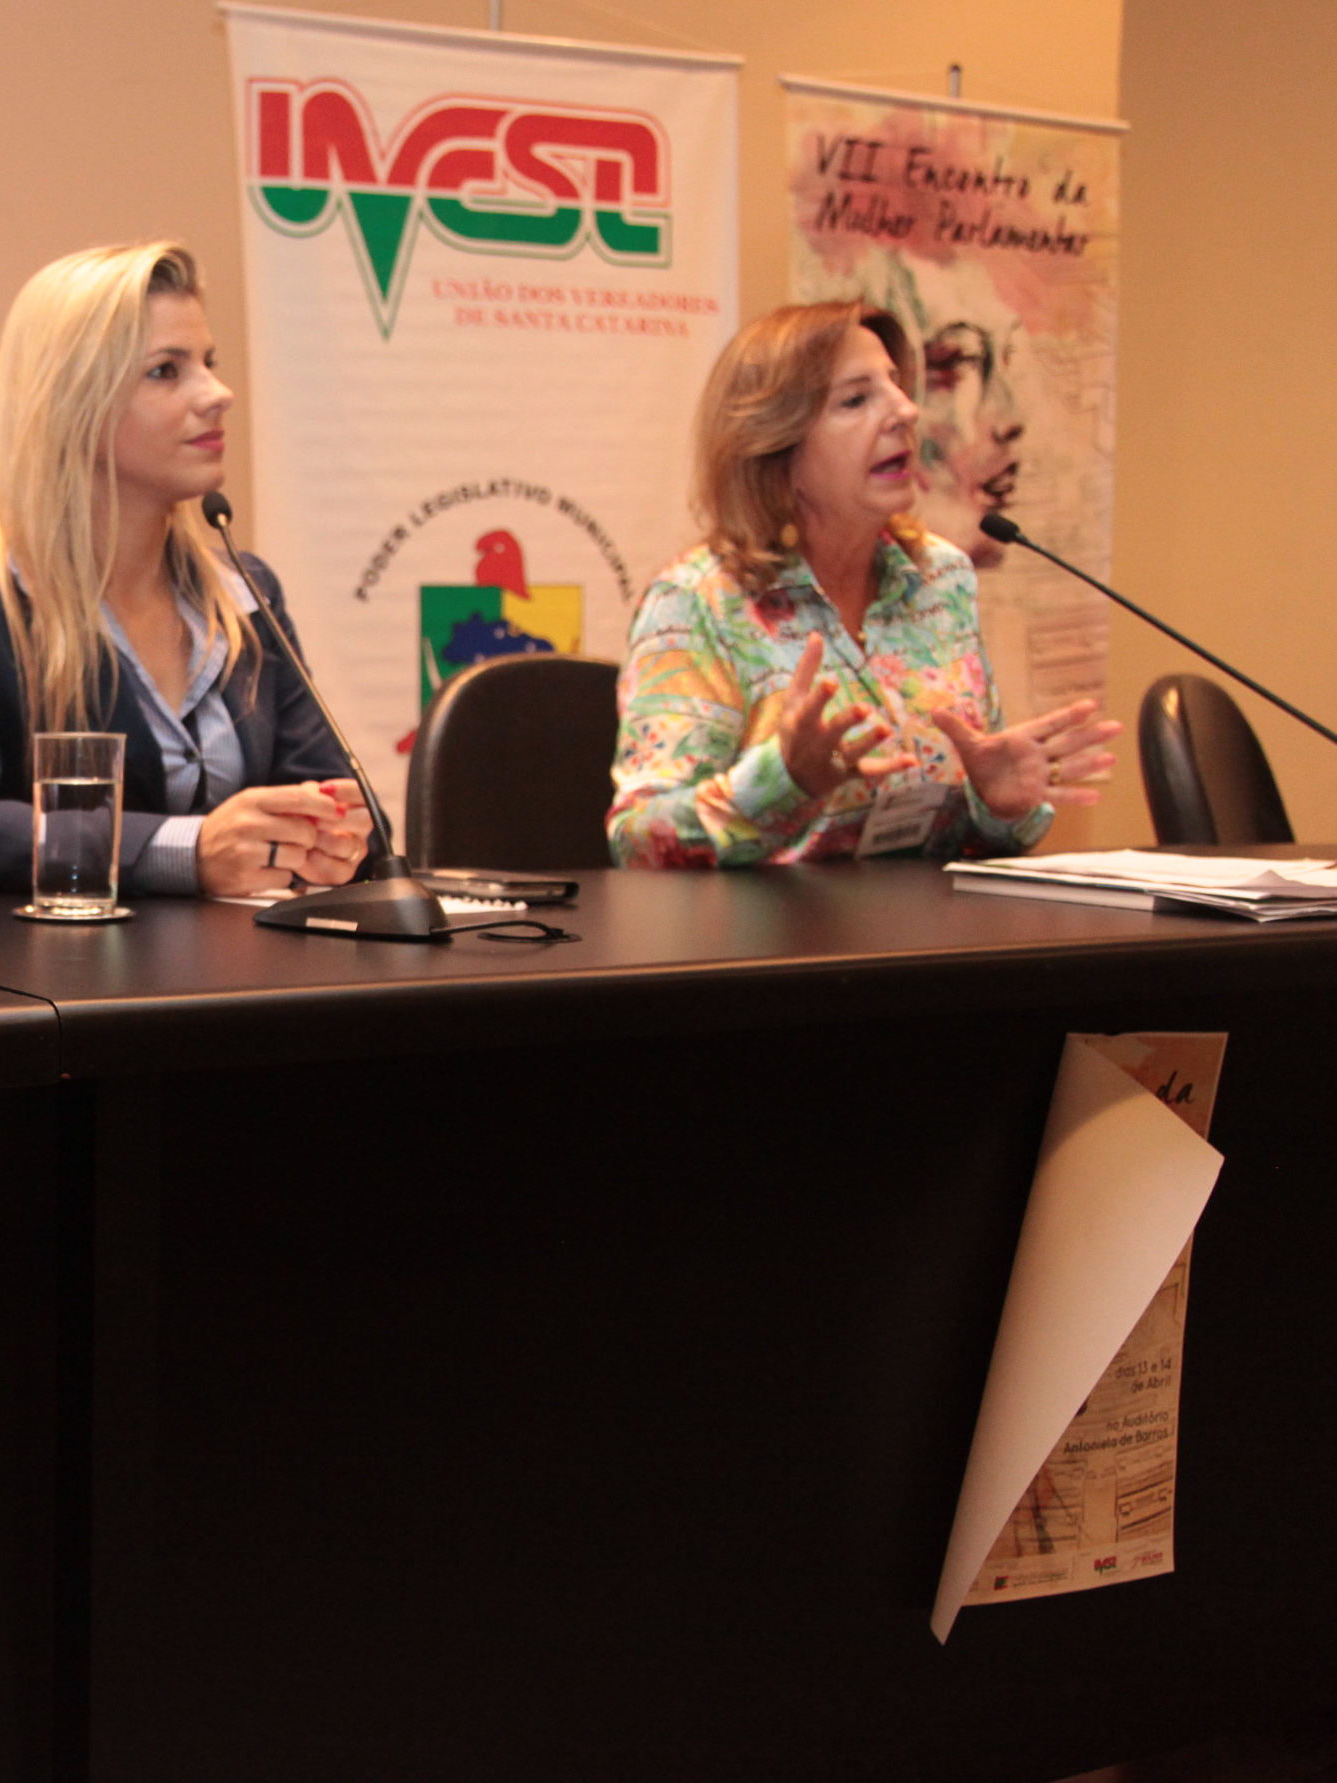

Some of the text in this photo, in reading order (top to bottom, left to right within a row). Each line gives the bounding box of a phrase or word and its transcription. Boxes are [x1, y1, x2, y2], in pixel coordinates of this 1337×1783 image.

[817, 133, 1087, 204] VII Encontro da
[816, 192, 1087, 256] Mulher Parlamentar
[431, 278, 513, 301] UNIÃO
[569, 287, 720, 316] VEREADORES
[493, 309, 571, 333] SANTA
[574, 313, 690, 339] CATARINA
[353, 523, 406, 603] PODER
[407, 477, 552, 528] LEGISLATIVO
[1156, 1070, 1194, 1105] da
[1147, 1375, 1172, 1390] Abril
[1151, 1363, 1158, 1373] e
[1136, 1428, 1169, 1443] Barros
